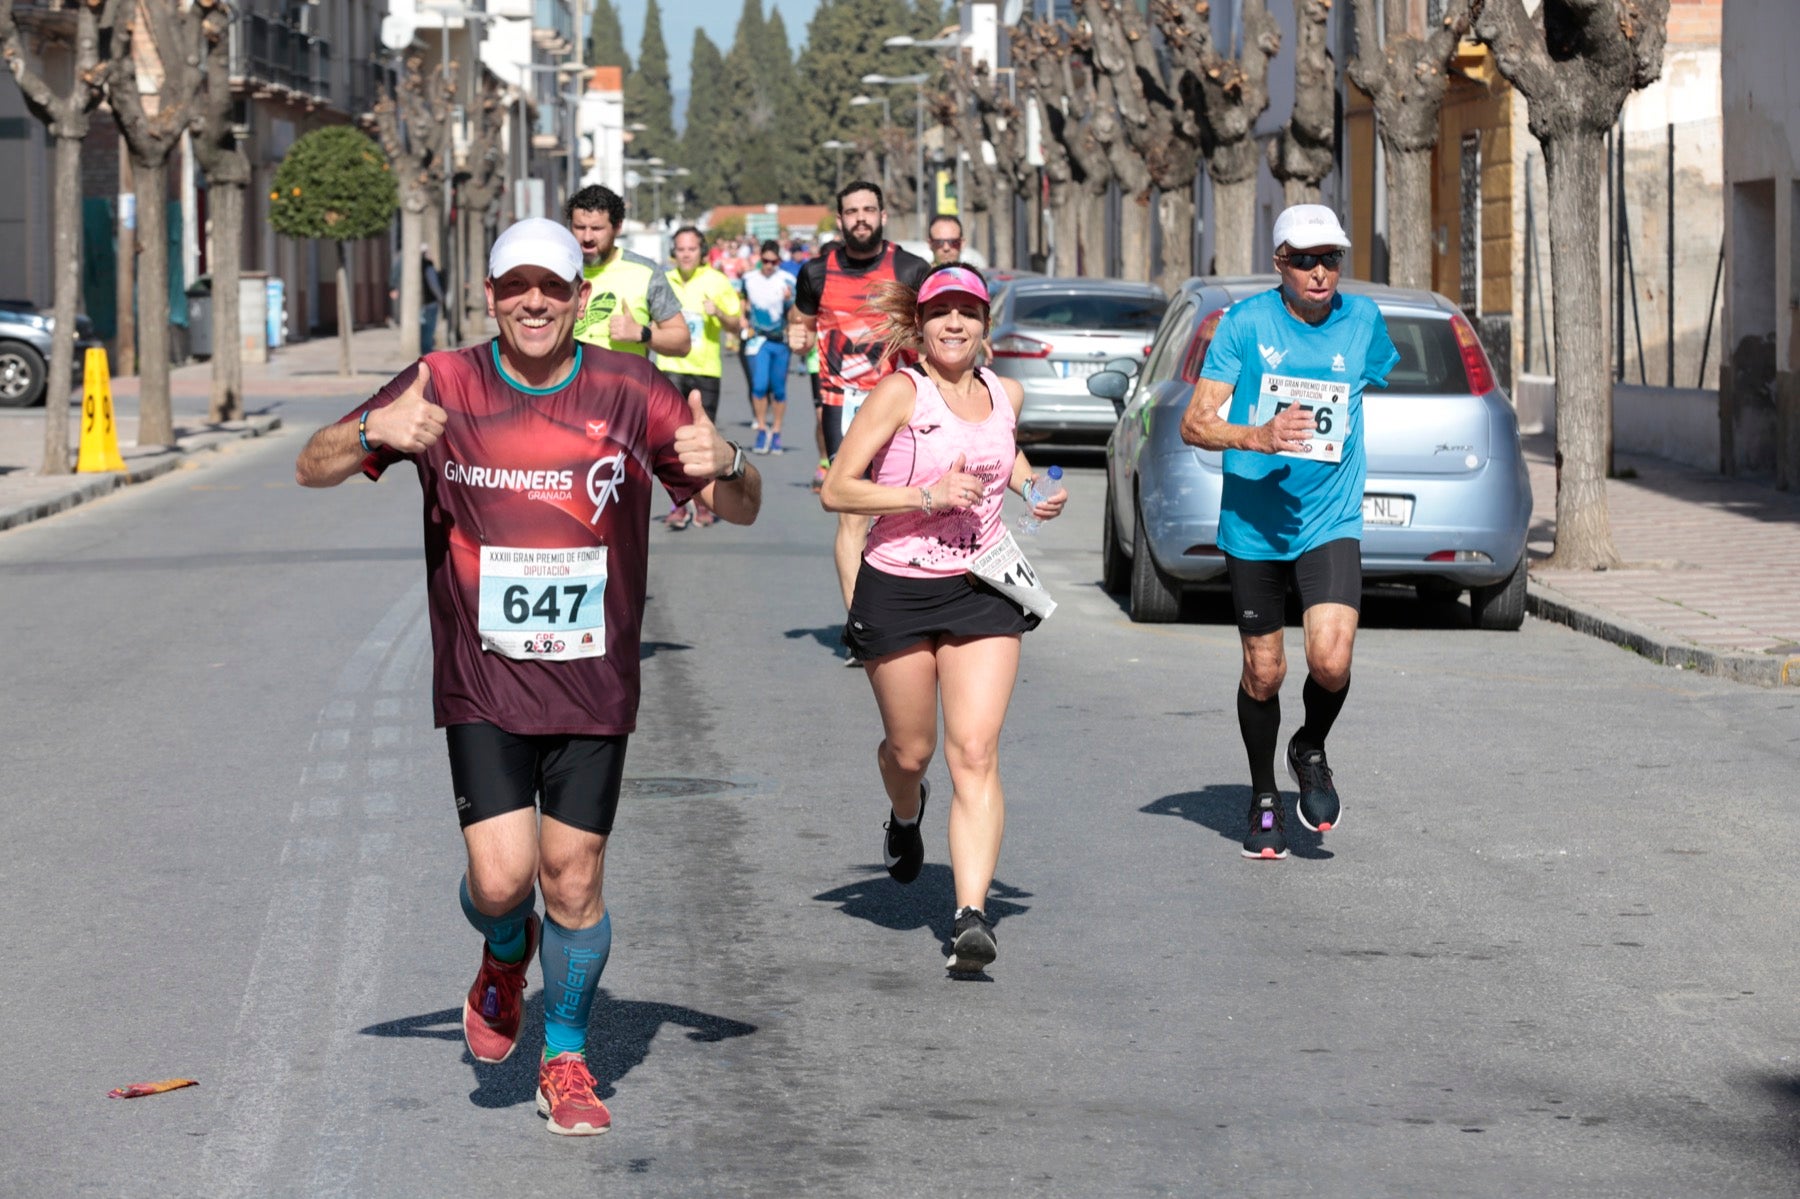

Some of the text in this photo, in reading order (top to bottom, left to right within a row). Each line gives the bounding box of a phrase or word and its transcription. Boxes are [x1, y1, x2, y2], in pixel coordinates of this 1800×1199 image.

[444, 459, 574, 490] GINRUNNERS
[527, 490, 572, 500] GRANADA
[490, 550, 600, 564] XXXIII GRAN PREMIO DE FONDO
[503, 584, 588, 624] 647
